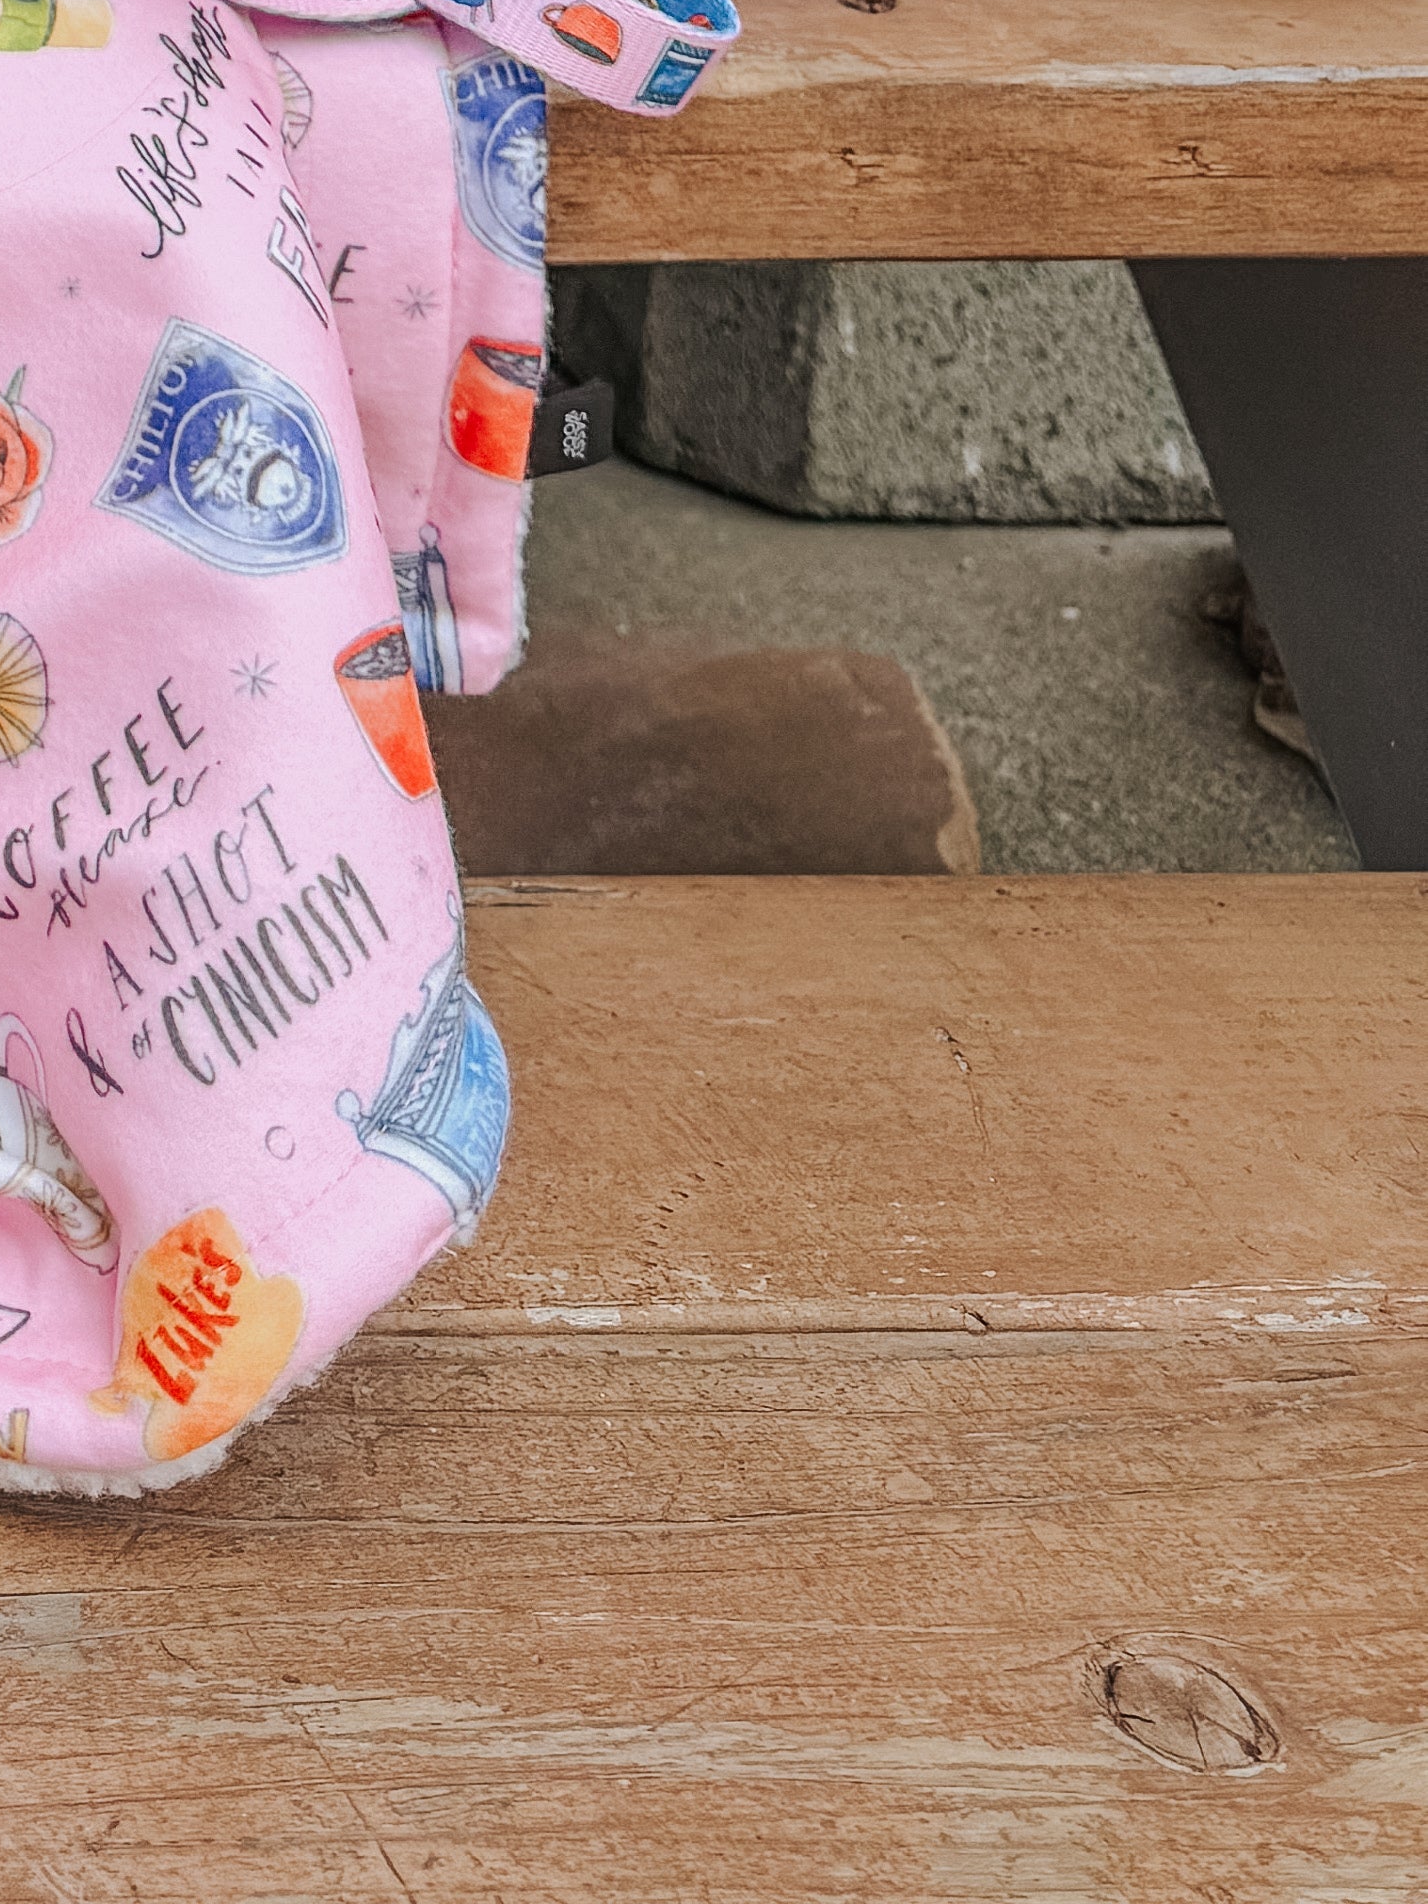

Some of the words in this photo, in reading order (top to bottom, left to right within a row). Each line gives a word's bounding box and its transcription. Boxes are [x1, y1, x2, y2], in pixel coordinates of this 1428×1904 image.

[64, 1007, 126, 1100] &
[159, 851, 394, 1088] CYNICISM
[102, 939, 143, 1012] A
[142, 785, 300, 969] SHOT
